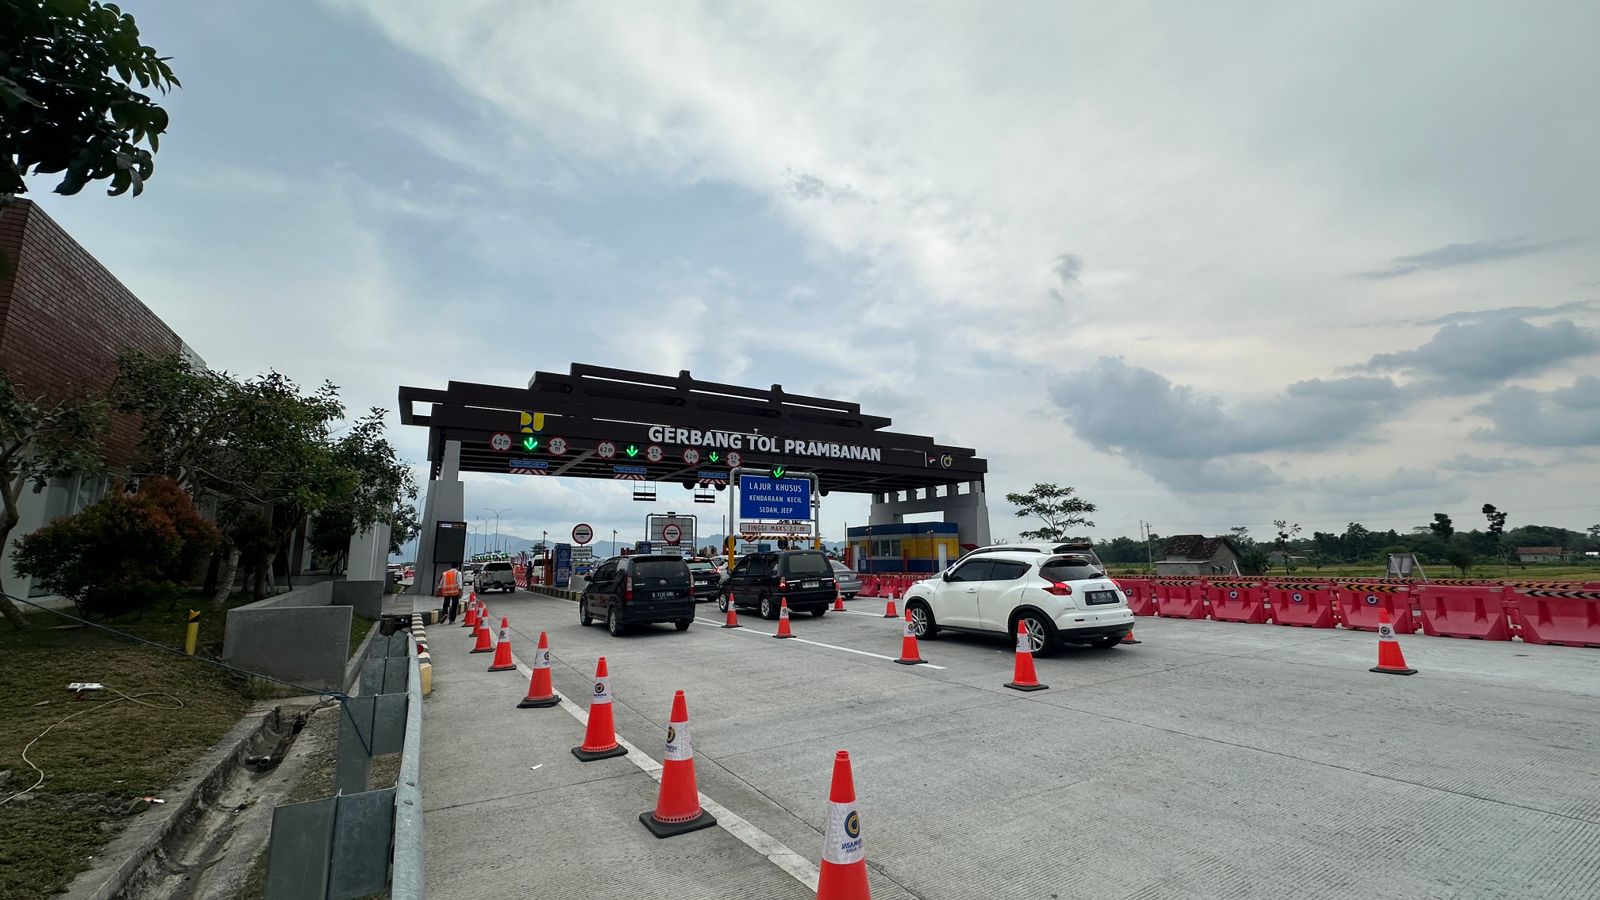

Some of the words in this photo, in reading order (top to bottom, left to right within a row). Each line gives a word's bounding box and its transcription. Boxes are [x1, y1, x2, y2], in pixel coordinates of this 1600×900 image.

[648, 426, 742, 449] GERBANG
[746, 435, 780, 453] TOL
[784, 439, 881, 462] PRAMBANAN
[749, 482, 772, 491] LAJUR
[775, 484, 802, 493] KHUSUS
[749, 495, 783, 503] KENDARAAN
